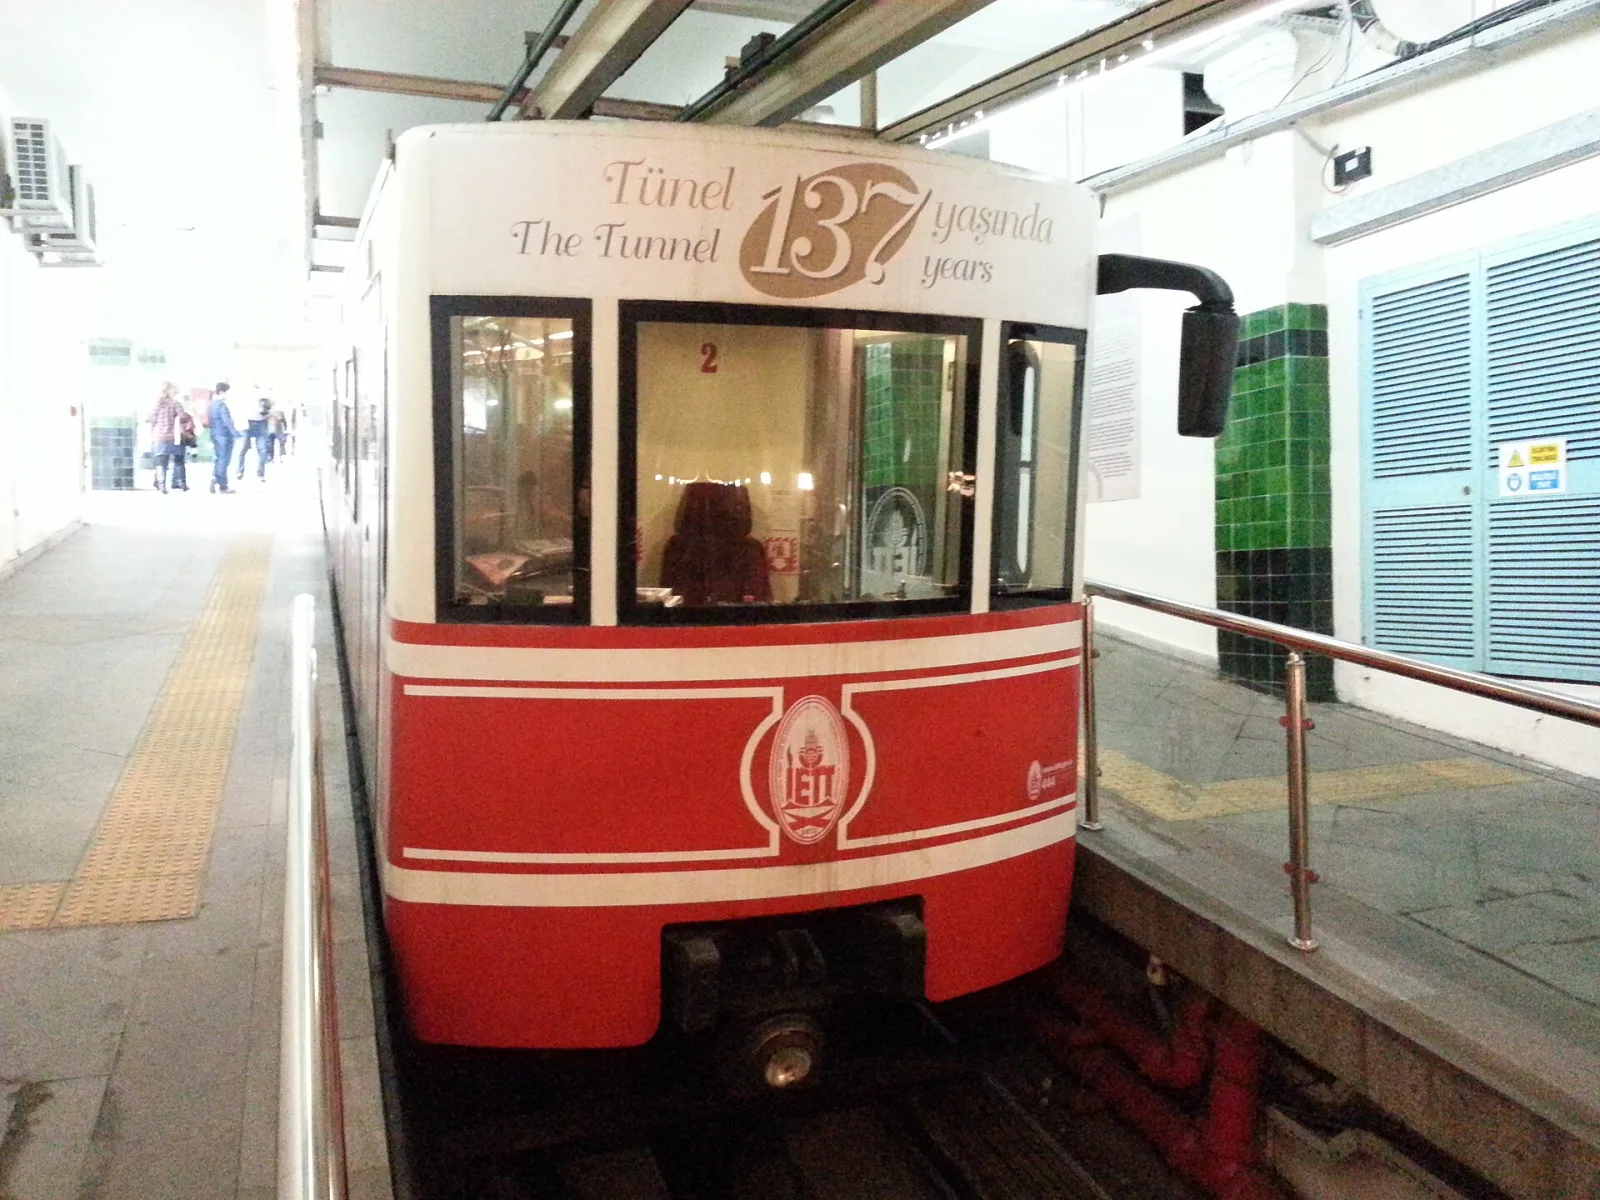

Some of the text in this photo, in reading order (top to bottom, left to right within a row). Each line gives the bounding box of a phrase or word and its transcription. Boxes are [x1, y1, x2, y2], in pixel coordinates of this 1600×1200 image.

[510, 218, 993, 290] The Tunnel years
[603, 157, 1054, 285] Tünel 137 yaşında
[700, 342, 719, 373] 2
